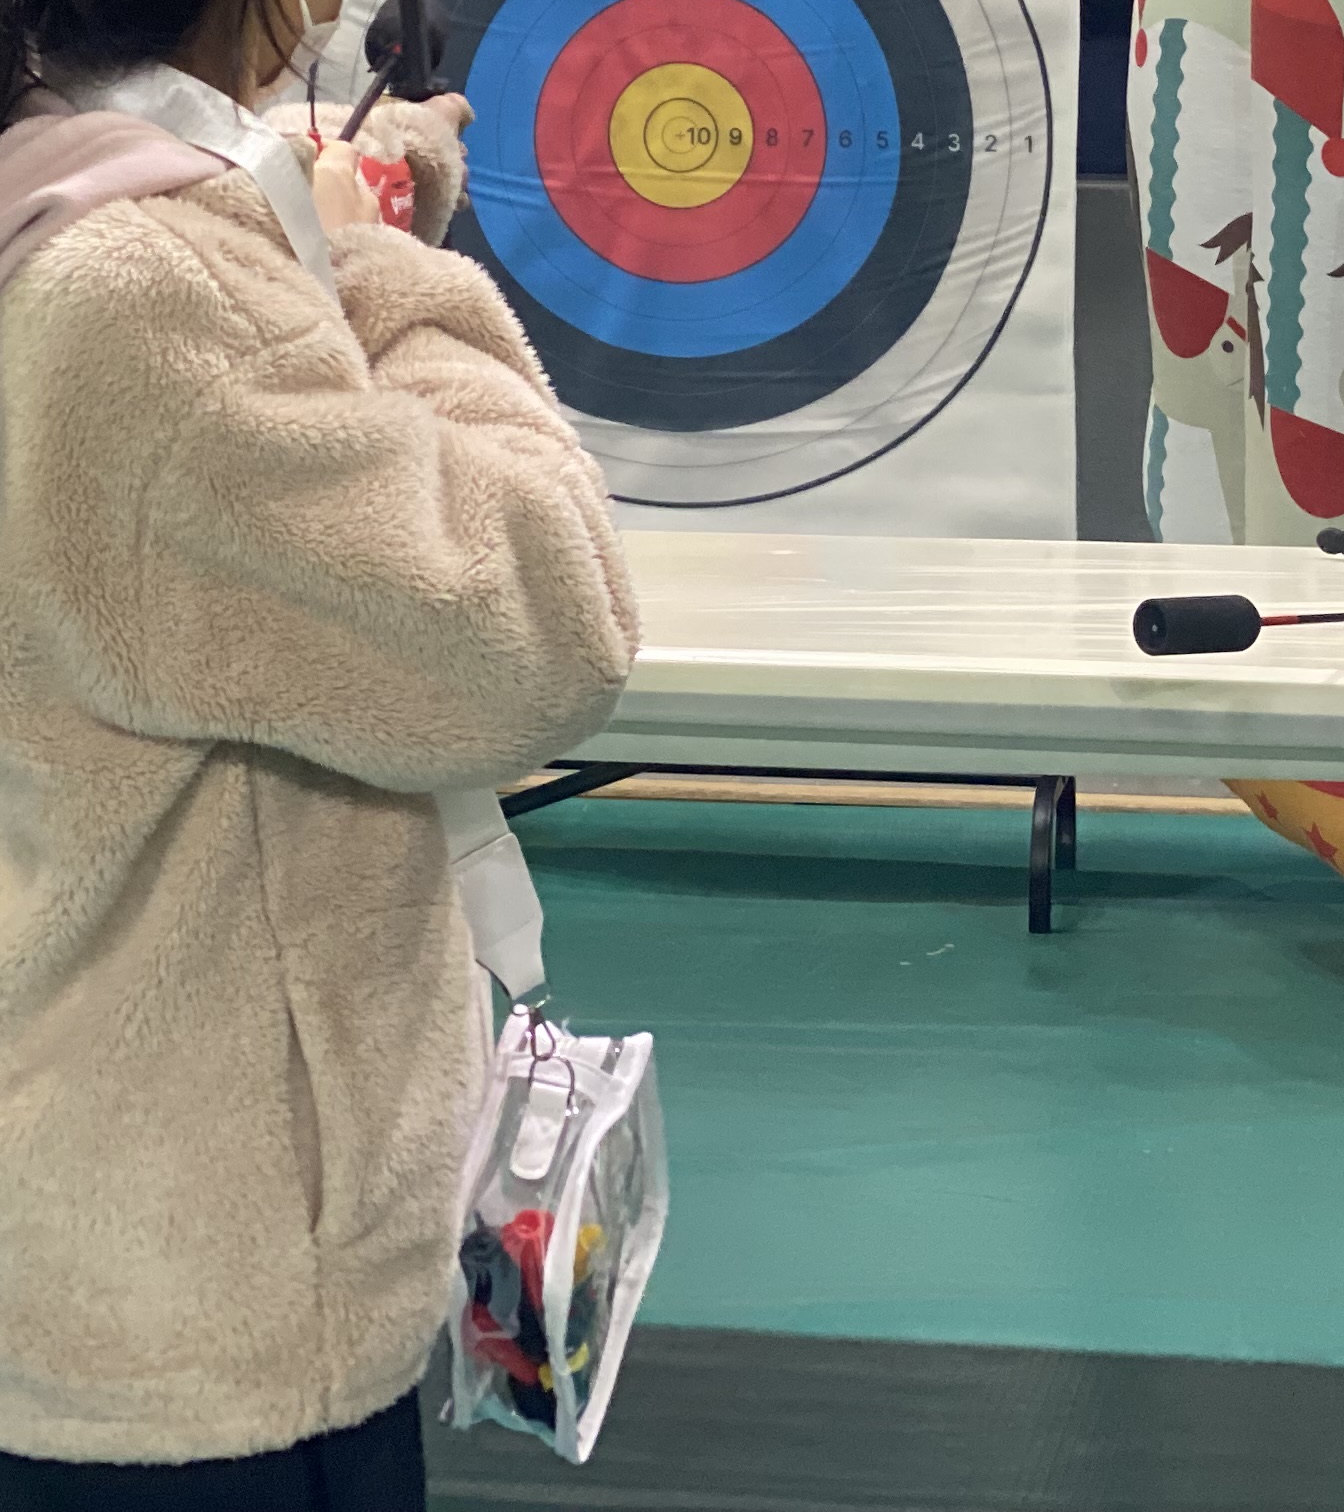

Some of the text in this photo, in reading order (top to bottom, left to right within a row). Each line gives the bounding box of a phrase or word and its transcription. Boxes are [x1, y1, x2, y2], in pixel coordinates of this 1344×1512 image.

[686, 127, 1034, 154] 10 9 8 7 6 5 4 3 2 1
